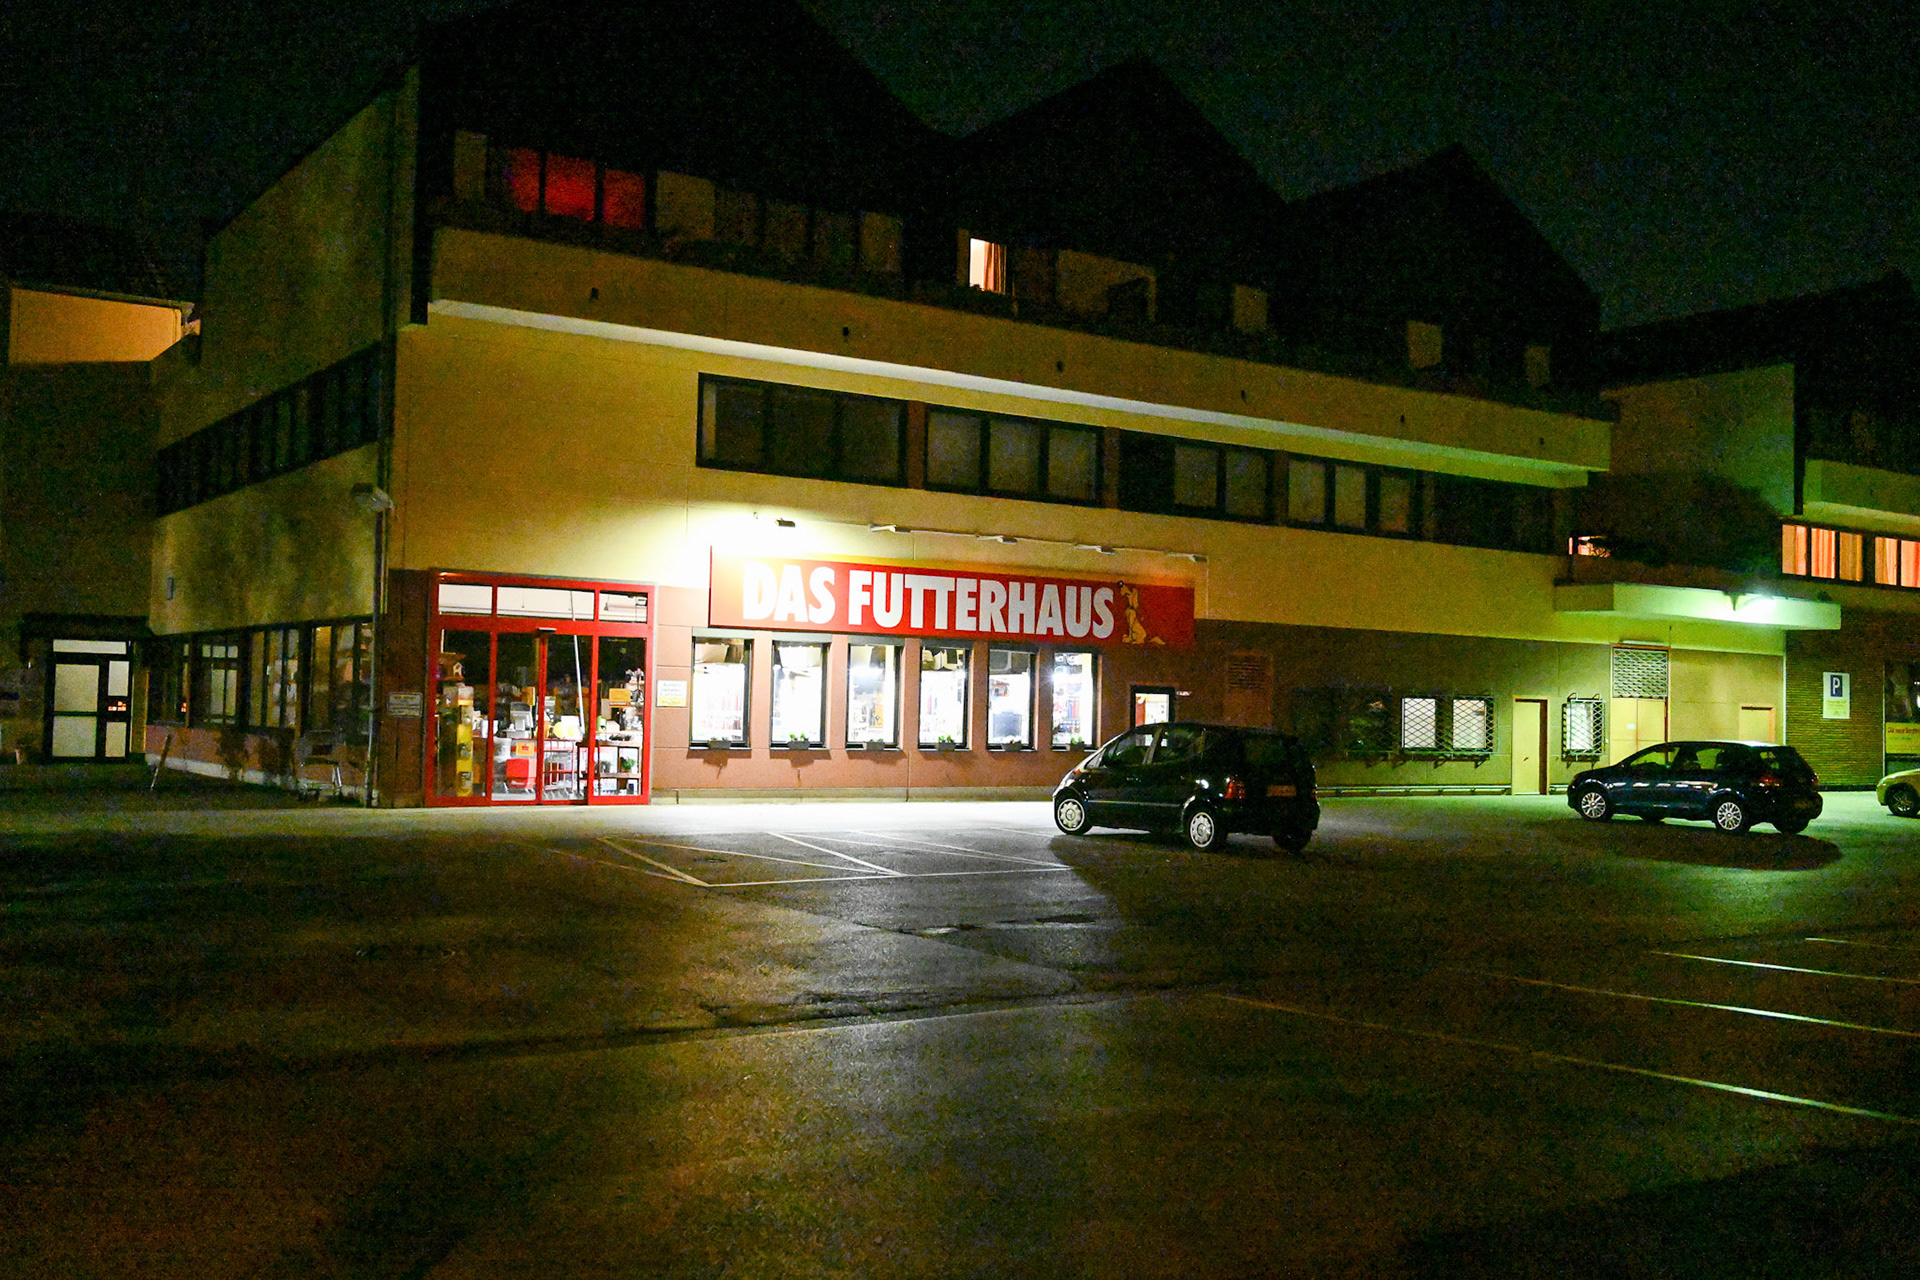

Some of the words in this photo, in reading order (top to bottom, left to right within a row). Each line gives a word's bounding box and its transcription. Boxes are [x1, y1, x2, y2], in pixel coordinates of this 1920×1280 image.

[742, 562, 835, 624] DAS
[848, 569, 1114, 639] FUTTERHAUS
[1832, 677, 1841, 695] P
